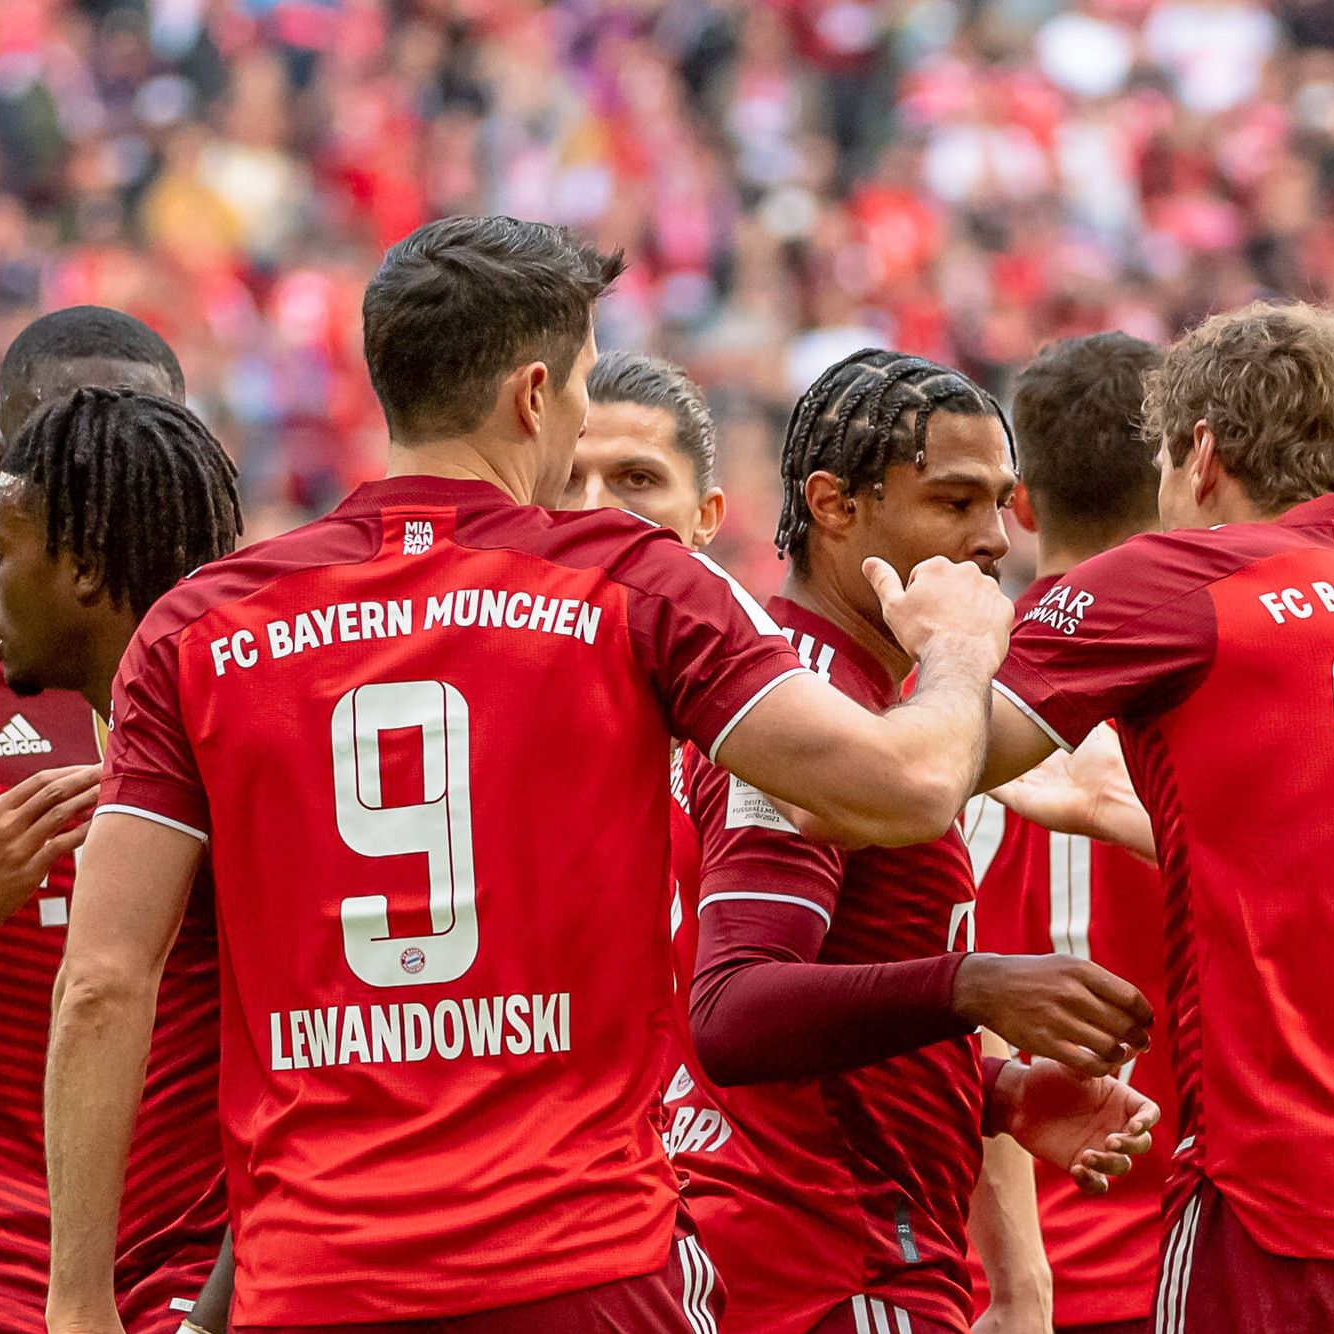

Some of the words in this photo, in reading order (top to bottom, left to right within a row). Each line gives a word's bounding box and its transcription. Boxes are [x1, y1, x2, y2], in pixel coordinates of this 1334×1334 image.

[404, 533, 434, 546] SAN
[405, 521, 434, 534] MIA
[210, 629, 260, 677] FC
[267, 599, 414, 660] BAYERN
[424, 588, 603, 645] MÜNCHEN
[1259, 588, 1313, 624] FC
[331, 679, 480, 988] 9
[270, 993, 572, 1071] LEWANDOWSKI
